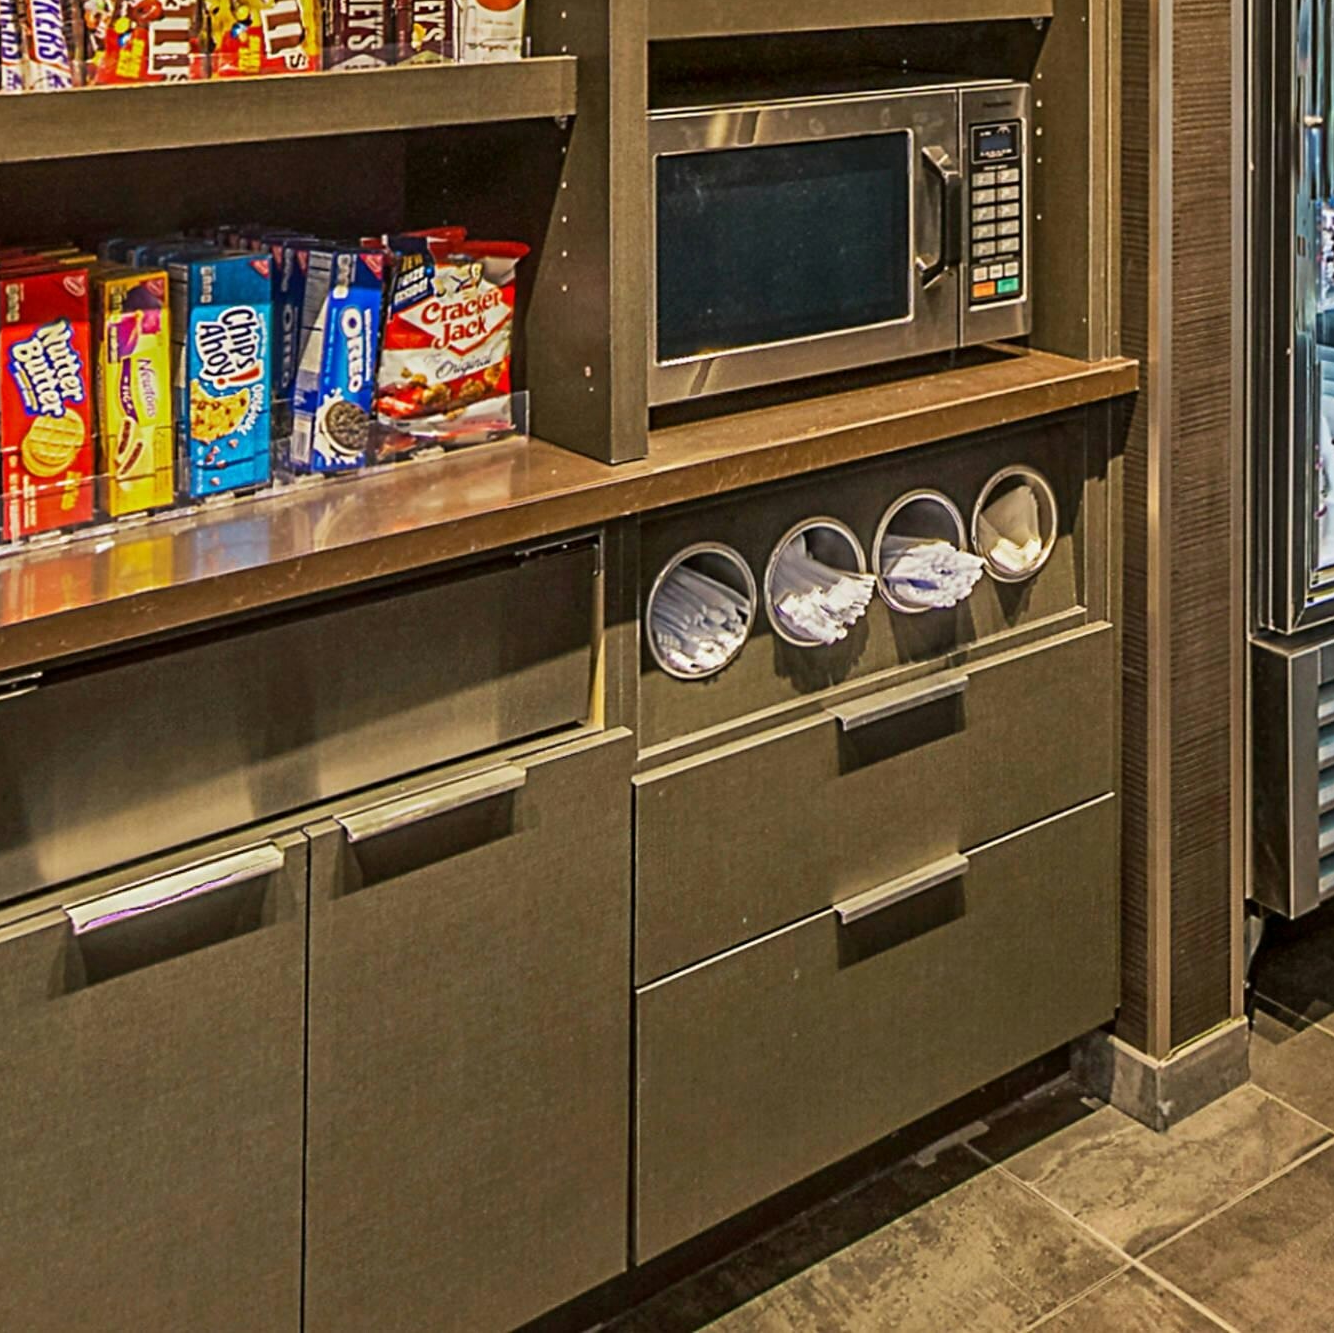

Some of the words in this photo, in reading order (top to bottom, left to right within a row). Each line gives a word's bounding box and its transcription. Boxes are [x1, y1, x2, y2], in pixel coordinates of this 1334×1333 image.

[420, 290, 501, 325] Cracker
[433, 315, 487, 350] Jack
[36, 319, 84, 402] Nutter
[221, 309, 259, 370] Chips
[341, 308, 364, 393] OREO
[12, 337, 63, 418] Butter
[136, 358, 158, 418] Newtons
